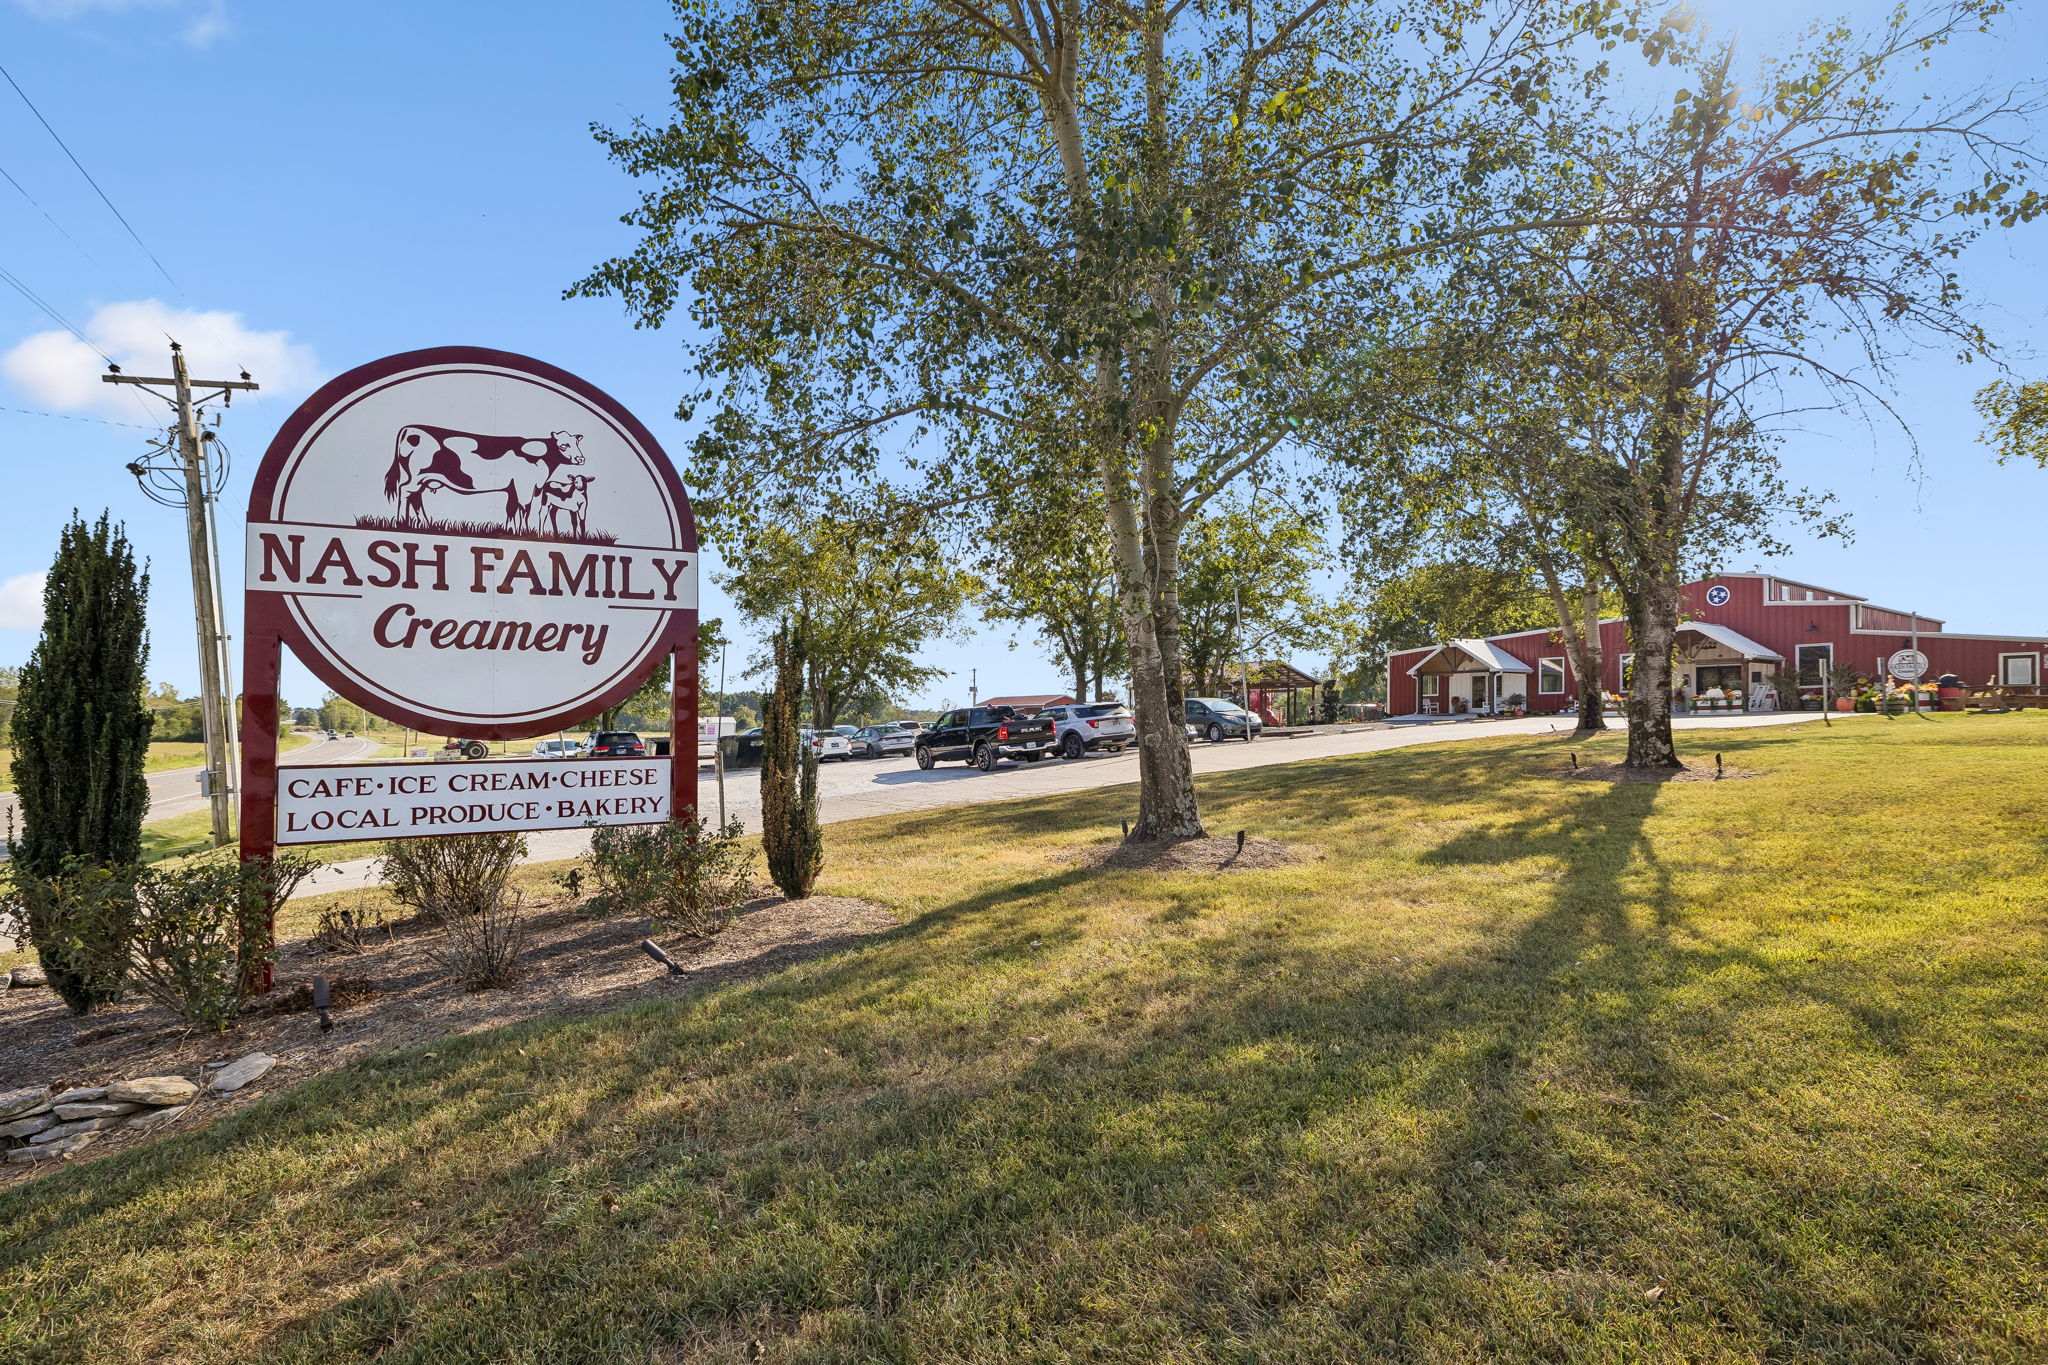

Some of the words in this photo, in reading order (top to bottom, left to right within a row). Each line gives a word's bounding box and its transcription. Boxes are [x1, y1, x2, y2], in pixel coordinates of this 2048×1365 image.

[259, 533, 449, 592] NASH
[470, 547, 689, 602] FAMILY
[373, 602, 610, 666] Creamery
[287, 777, 374, 799] CAFE
[388, 775, 438, 796] ICE
[448, 771, 551, 793] CREAM
[559, 768, 658, 789] CHEESE
[286, 807, 401, 833] LOCAL
[410, 801, 541, 826] PRODUCE
[557, 795, 664, 819] BAKERY
